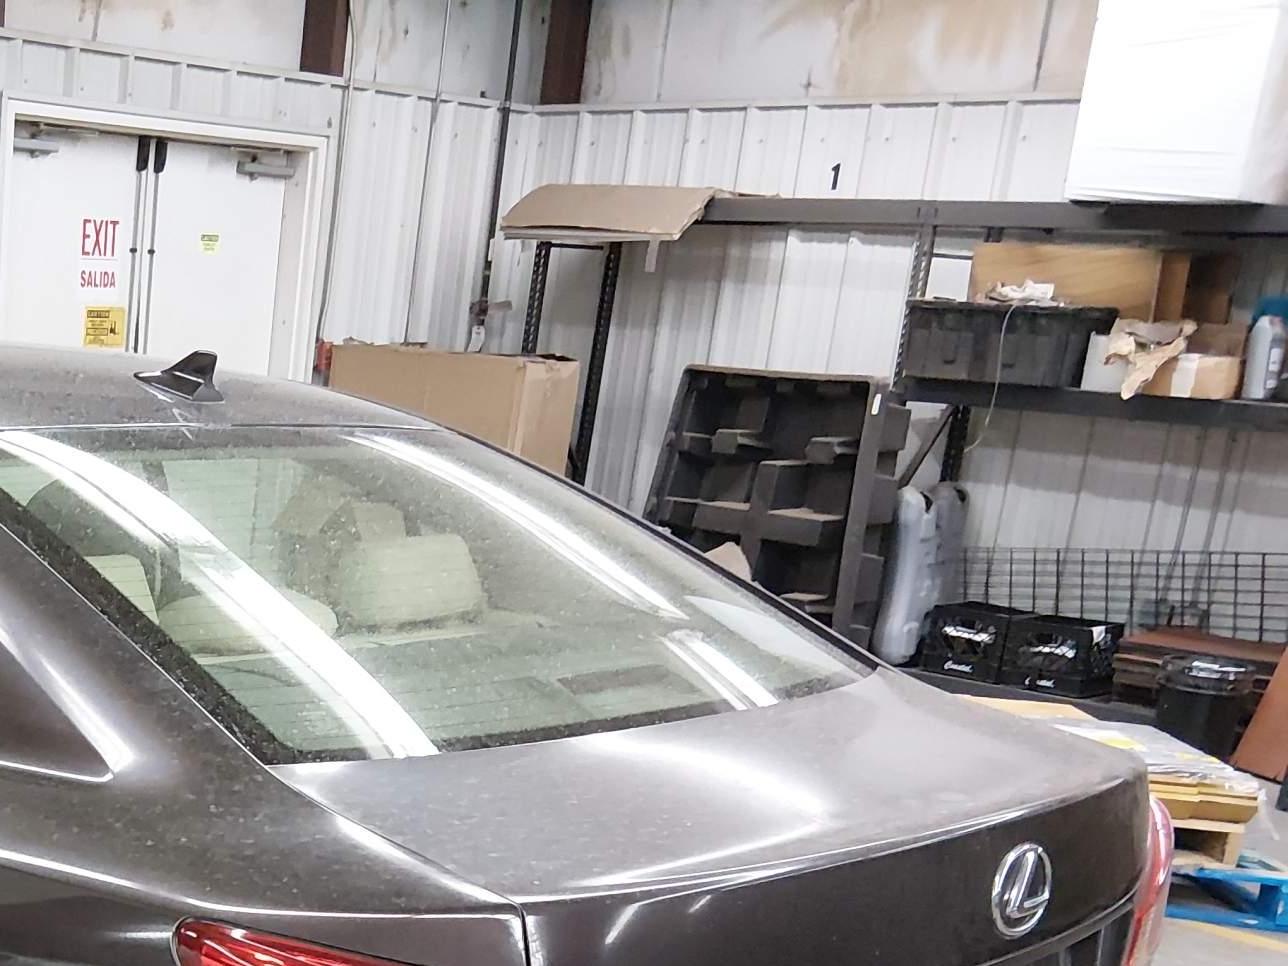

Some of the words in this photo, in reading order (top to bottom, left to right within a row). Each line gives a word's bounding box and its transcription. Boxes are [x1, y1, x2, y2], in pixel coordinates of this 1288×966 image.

[831, 162, 841, 191] 1
[81, 218, 120, 257] EXIT
[80, 269, 117, 289] SALIDA
